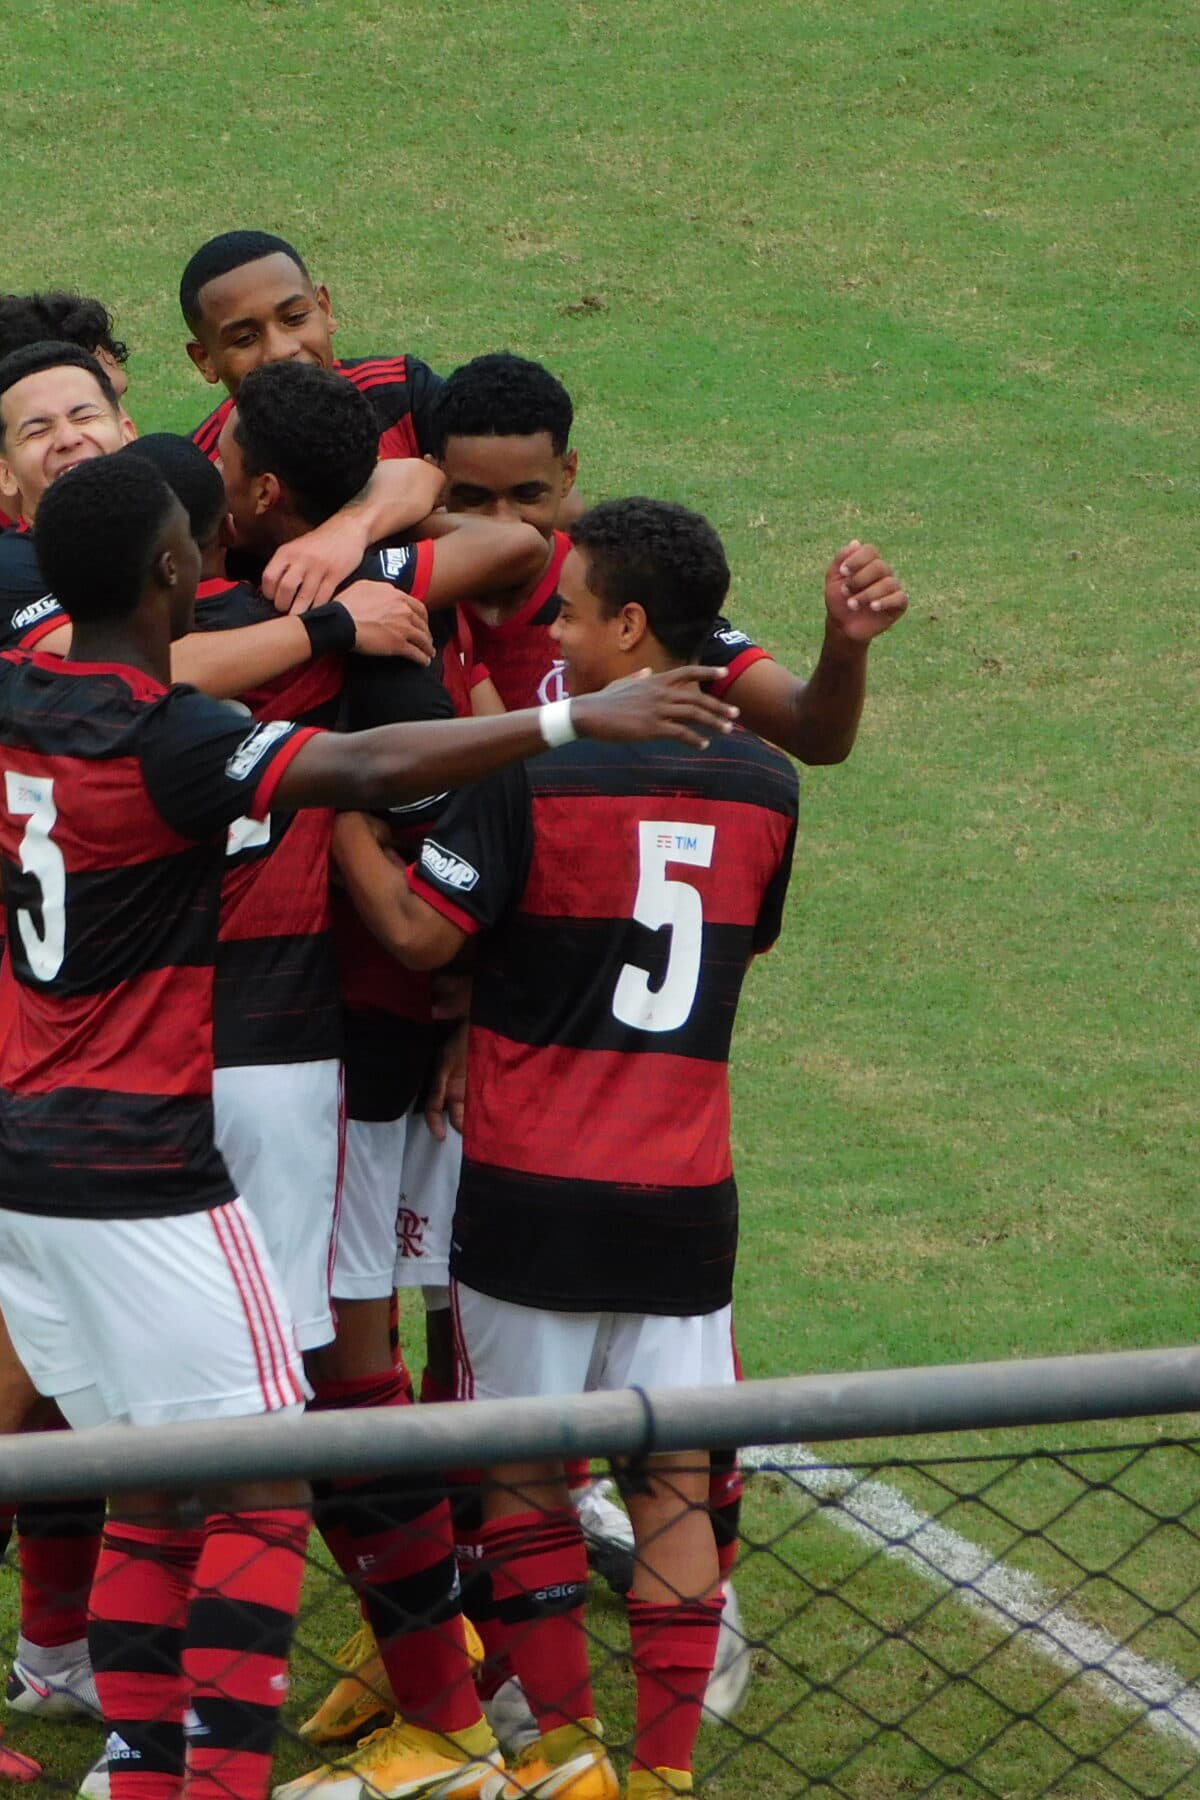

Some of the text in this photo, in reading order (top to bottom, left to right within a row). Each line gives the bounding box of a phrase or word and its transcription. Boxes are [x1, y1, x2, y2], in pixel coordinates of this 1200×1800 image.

[4, 770, 66, 983] 3
[612, 821, 716, 1032] 5
[674, 834, 698, 851] TIM
